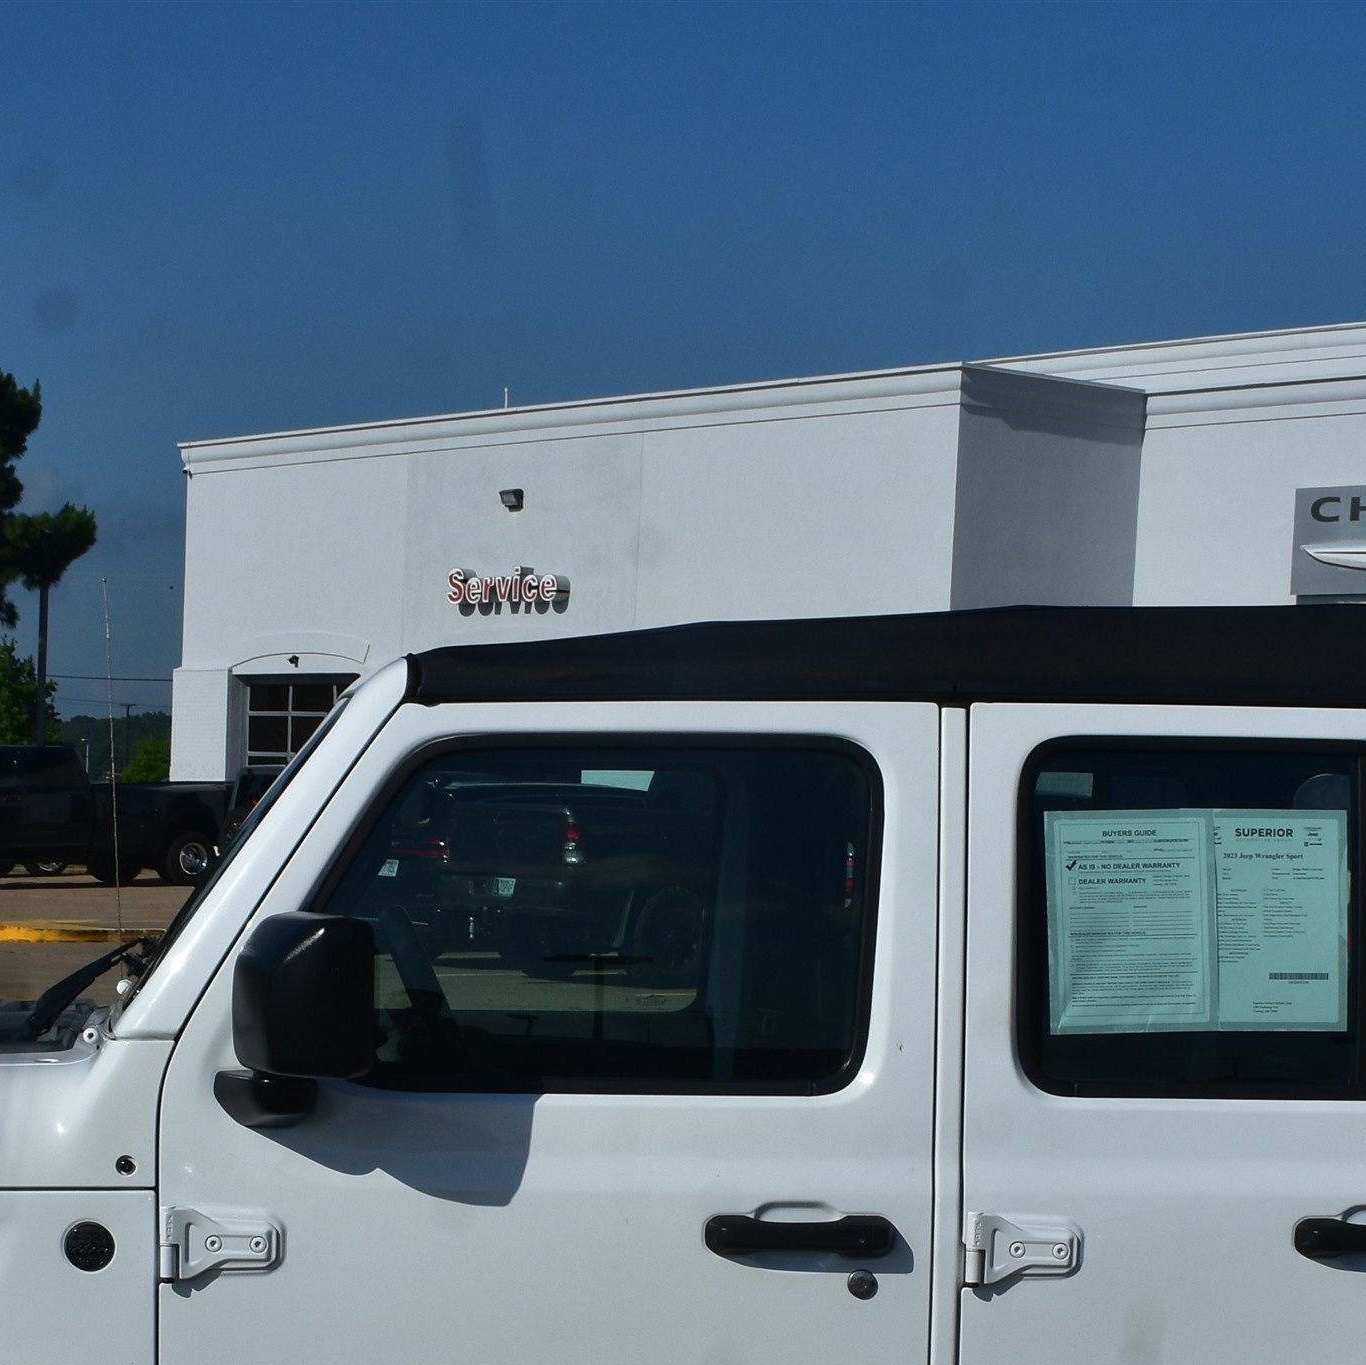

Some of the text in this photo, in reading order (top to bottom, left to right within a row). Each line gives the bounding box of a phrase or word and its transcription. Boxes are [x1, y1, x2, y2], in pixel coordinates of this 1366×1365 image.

[446, 565, 558, 605] Service
[1134, 829, 1157, 837] GUIDE
[1235, 828, 1293, 837] SUPERIOR
